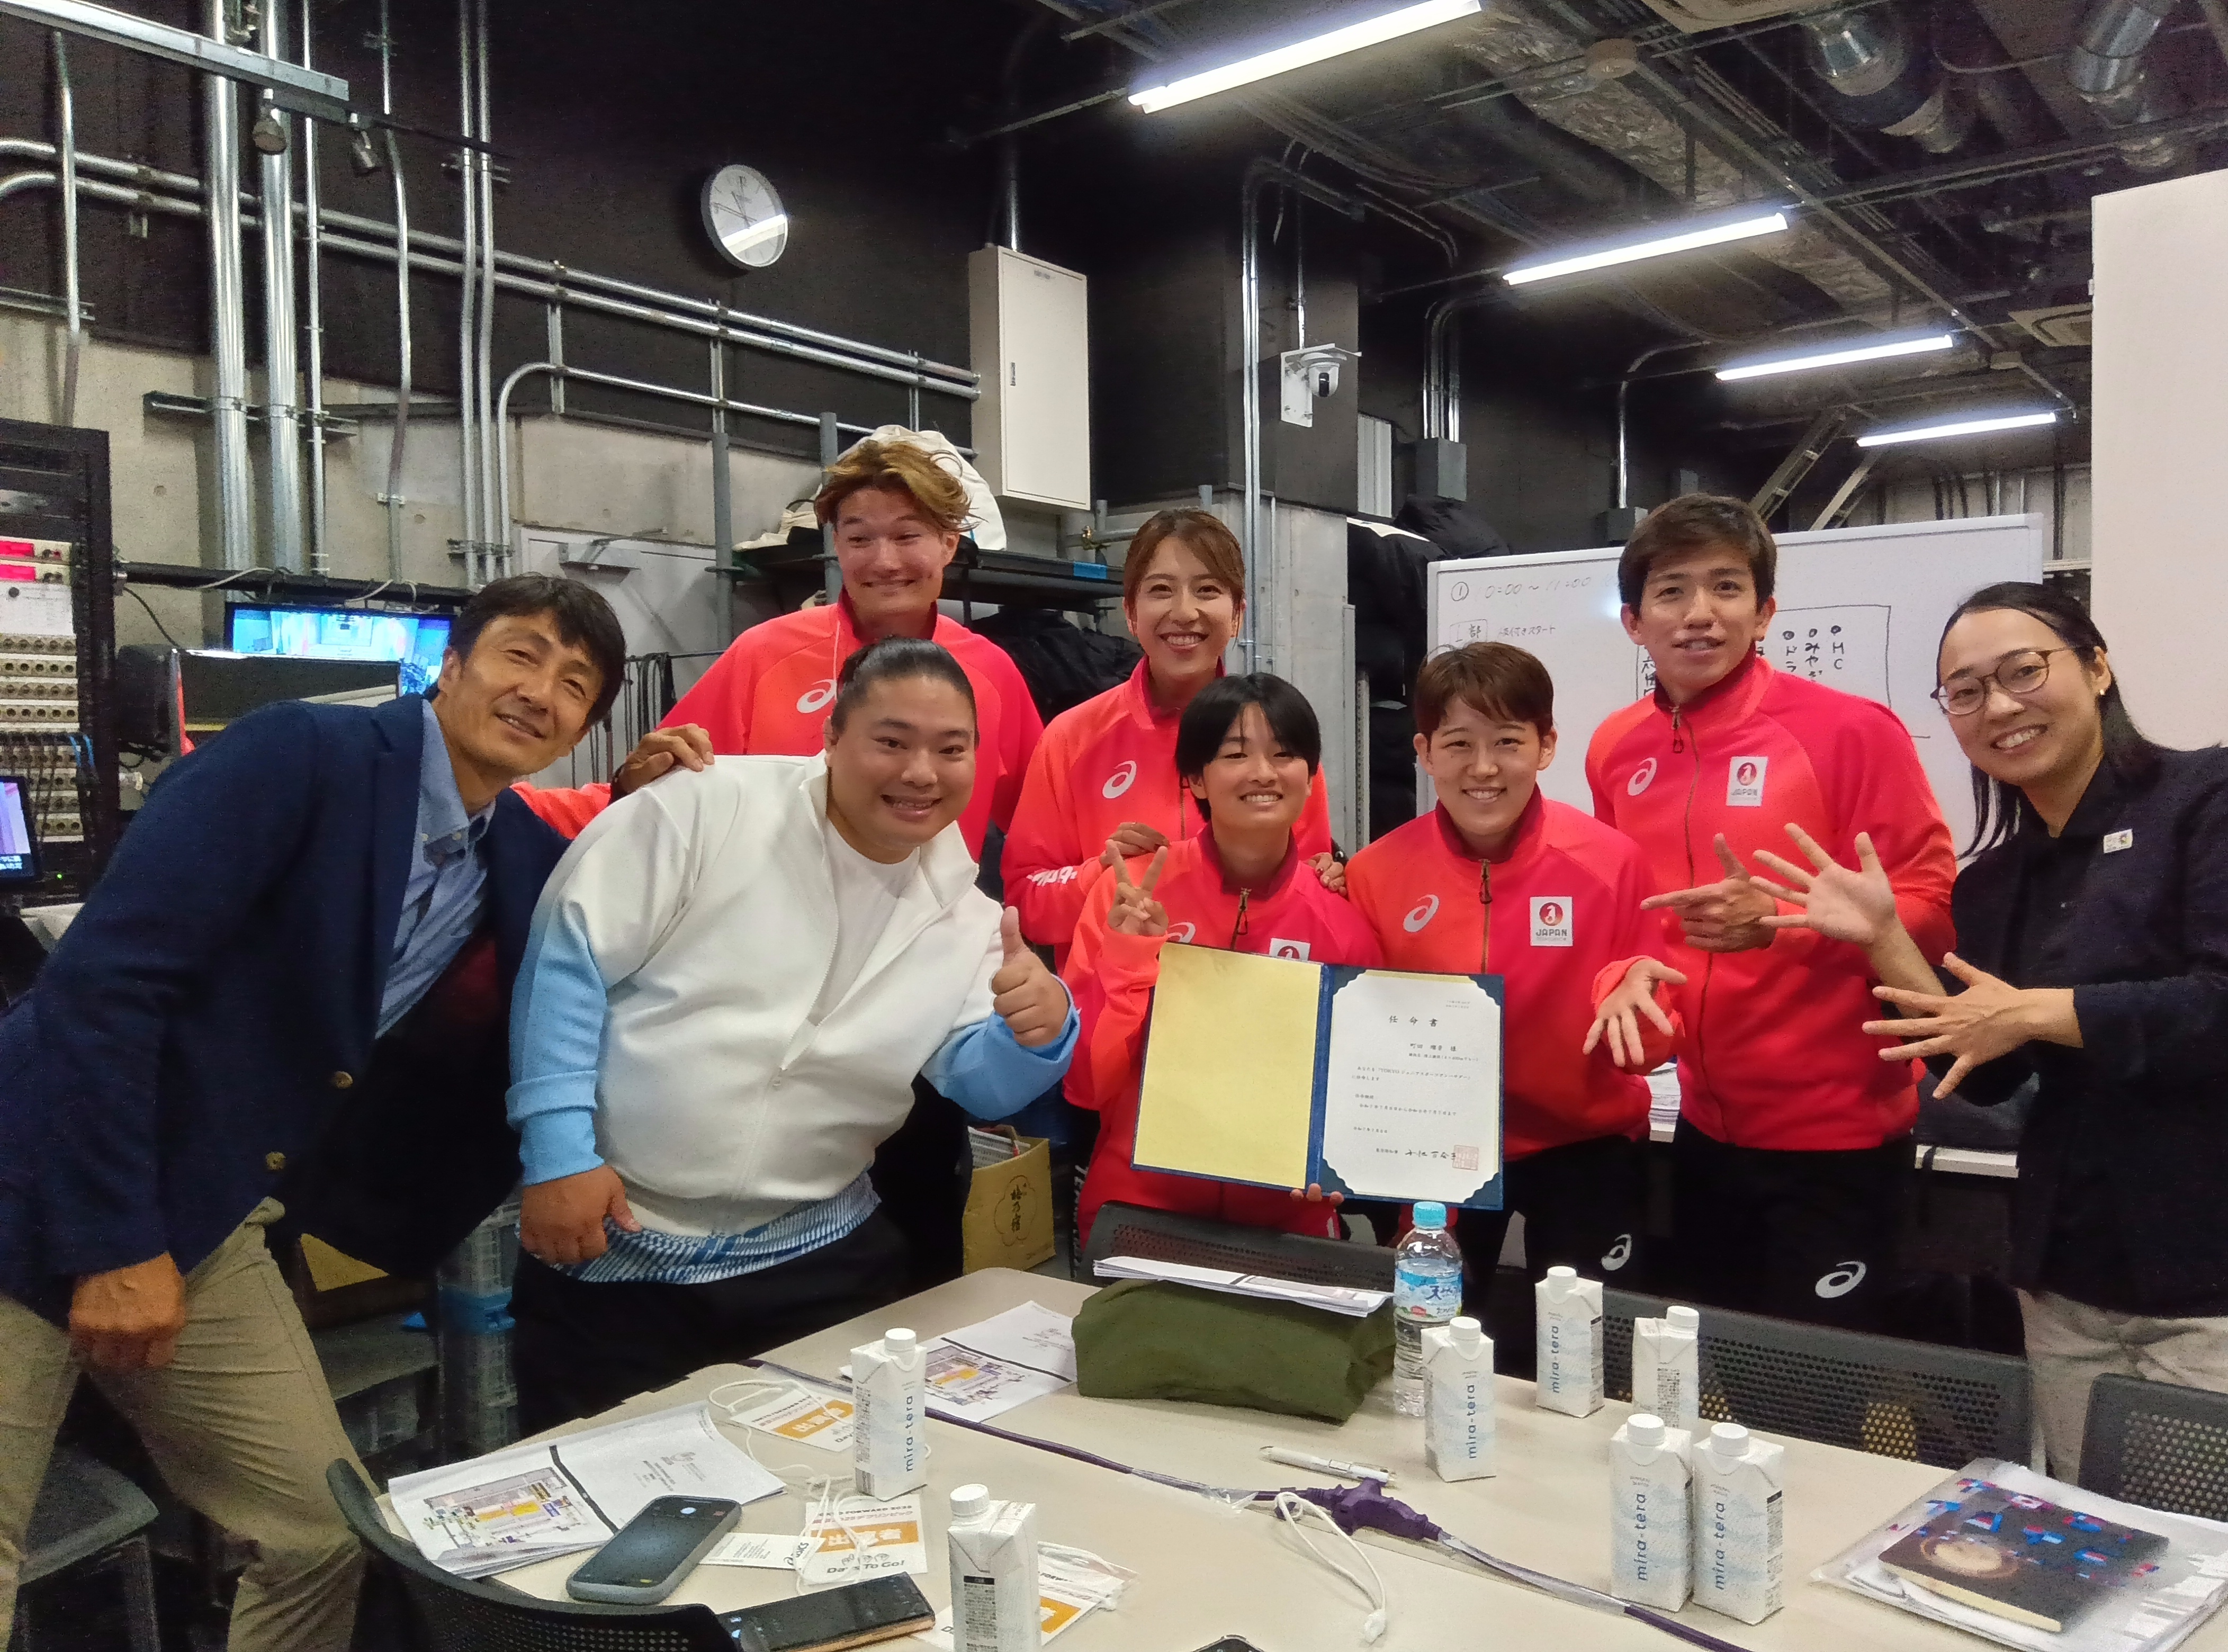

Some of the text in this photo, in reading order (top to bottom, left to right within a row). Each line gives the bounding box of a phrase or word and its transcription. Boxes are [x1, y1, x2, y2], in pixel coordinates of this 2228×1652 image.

[1479, 583, 1522, 599] 0:00
[1550, 1325, 1560, 1394] mira-tera
[903, 1396, 913, 1472] mira-tera
[1466, 1385, 1477, 1459] mira-tera
[1633, 1493, 1648, 1581] mira-tera
[1712, 1502, 1725, 1590] mira-tera
